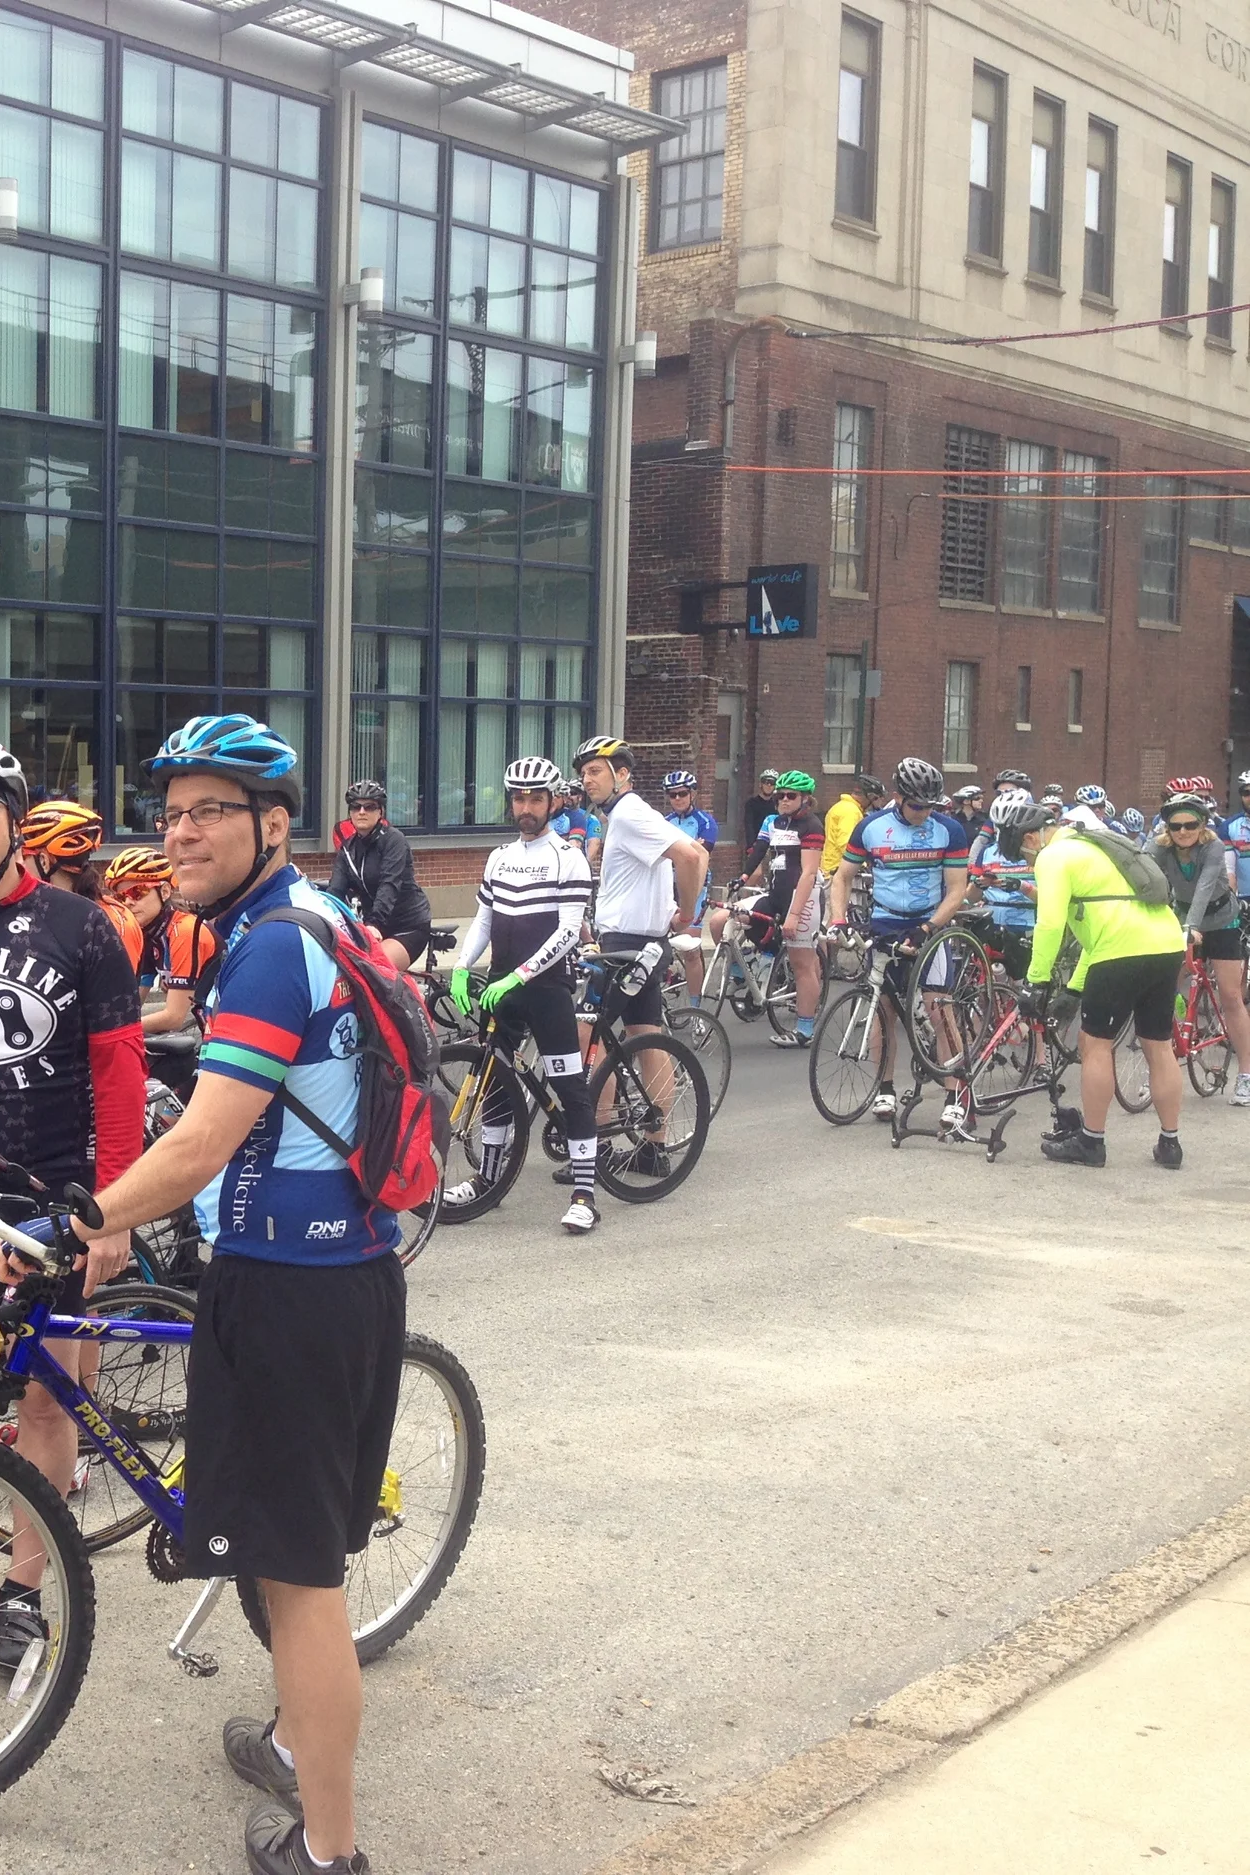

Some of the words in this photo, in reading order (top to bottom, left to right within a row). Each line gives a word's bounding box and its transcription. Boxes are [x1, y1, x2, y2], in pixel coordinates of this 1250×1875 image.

[232, 1135, 272, 1233] Medicine
[307, 1219, 347, 1234] DNA
[304, 1231, 345, 1240] CYCLING
